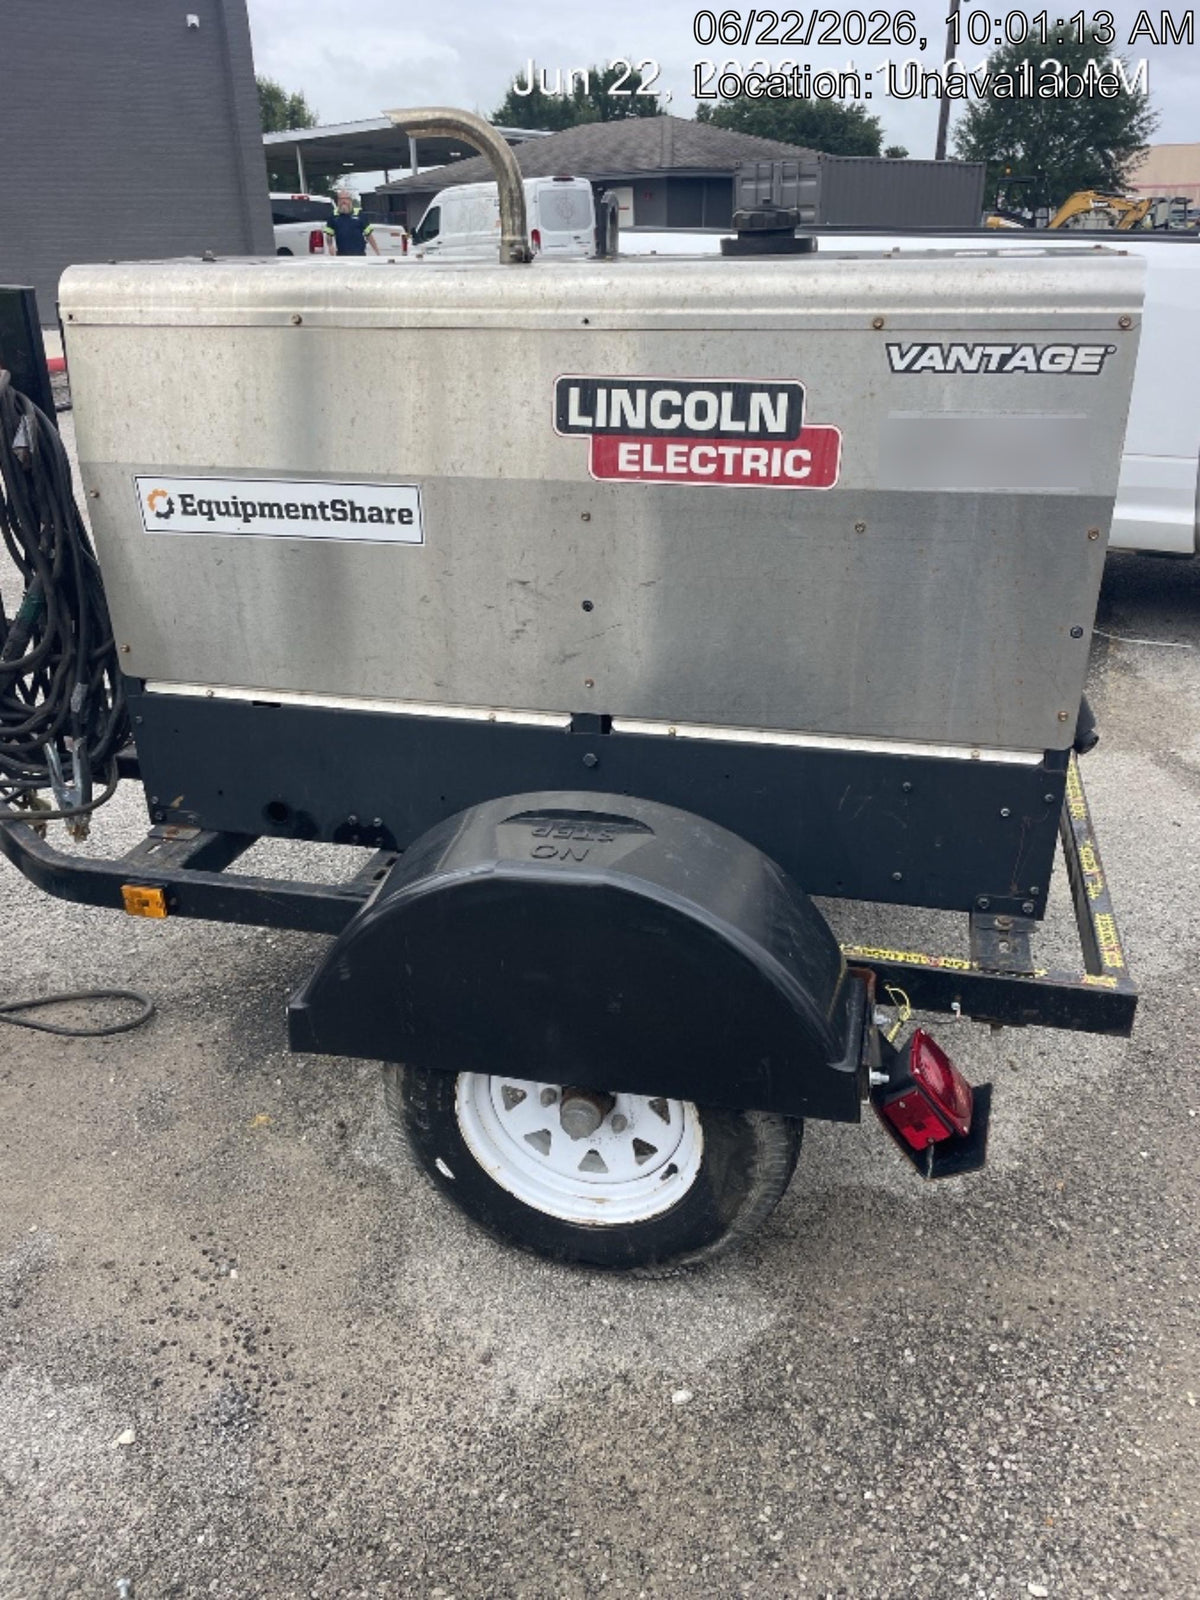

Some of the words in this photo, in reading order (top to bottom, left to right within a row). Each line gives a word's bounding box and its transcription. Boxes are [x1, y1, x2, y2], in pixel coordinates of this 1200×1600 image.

[885, 343, 1109, 375] VANTAGE
[567, 386, 789, 433] LINCOLN
[617, 442, 812, 479] ELECTRIC
[177, 493, 414, 525] EquipmentShare
[531, 845, 590, 862] NO
